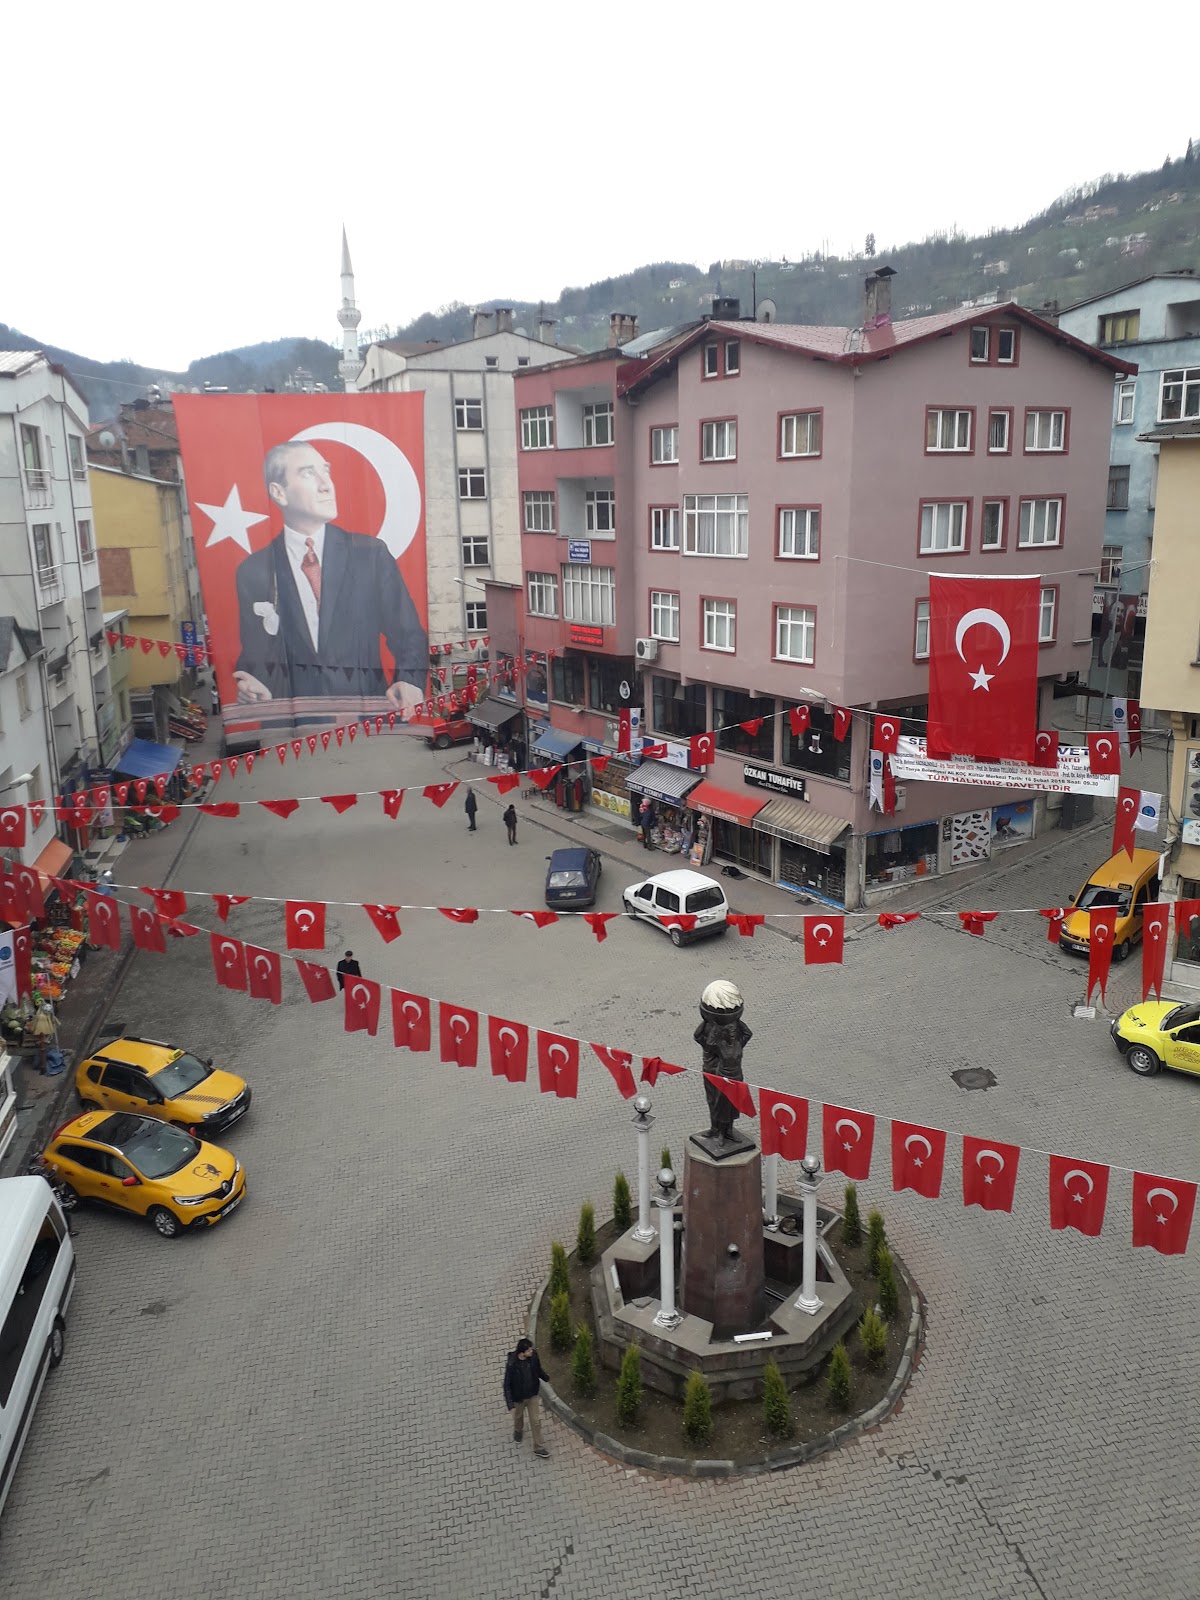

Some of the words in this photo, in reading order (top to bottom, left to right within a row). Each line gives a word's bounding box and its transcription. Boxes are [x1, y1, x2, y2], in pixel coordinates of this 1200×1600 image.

[744, 765, 767, 781] ÖZKAN
[768, 773, 803, 791] TUHAFİYE
[928, 774, 949, 782] TÜM
[952, 776, 1003, 787] HALKIMIZ
